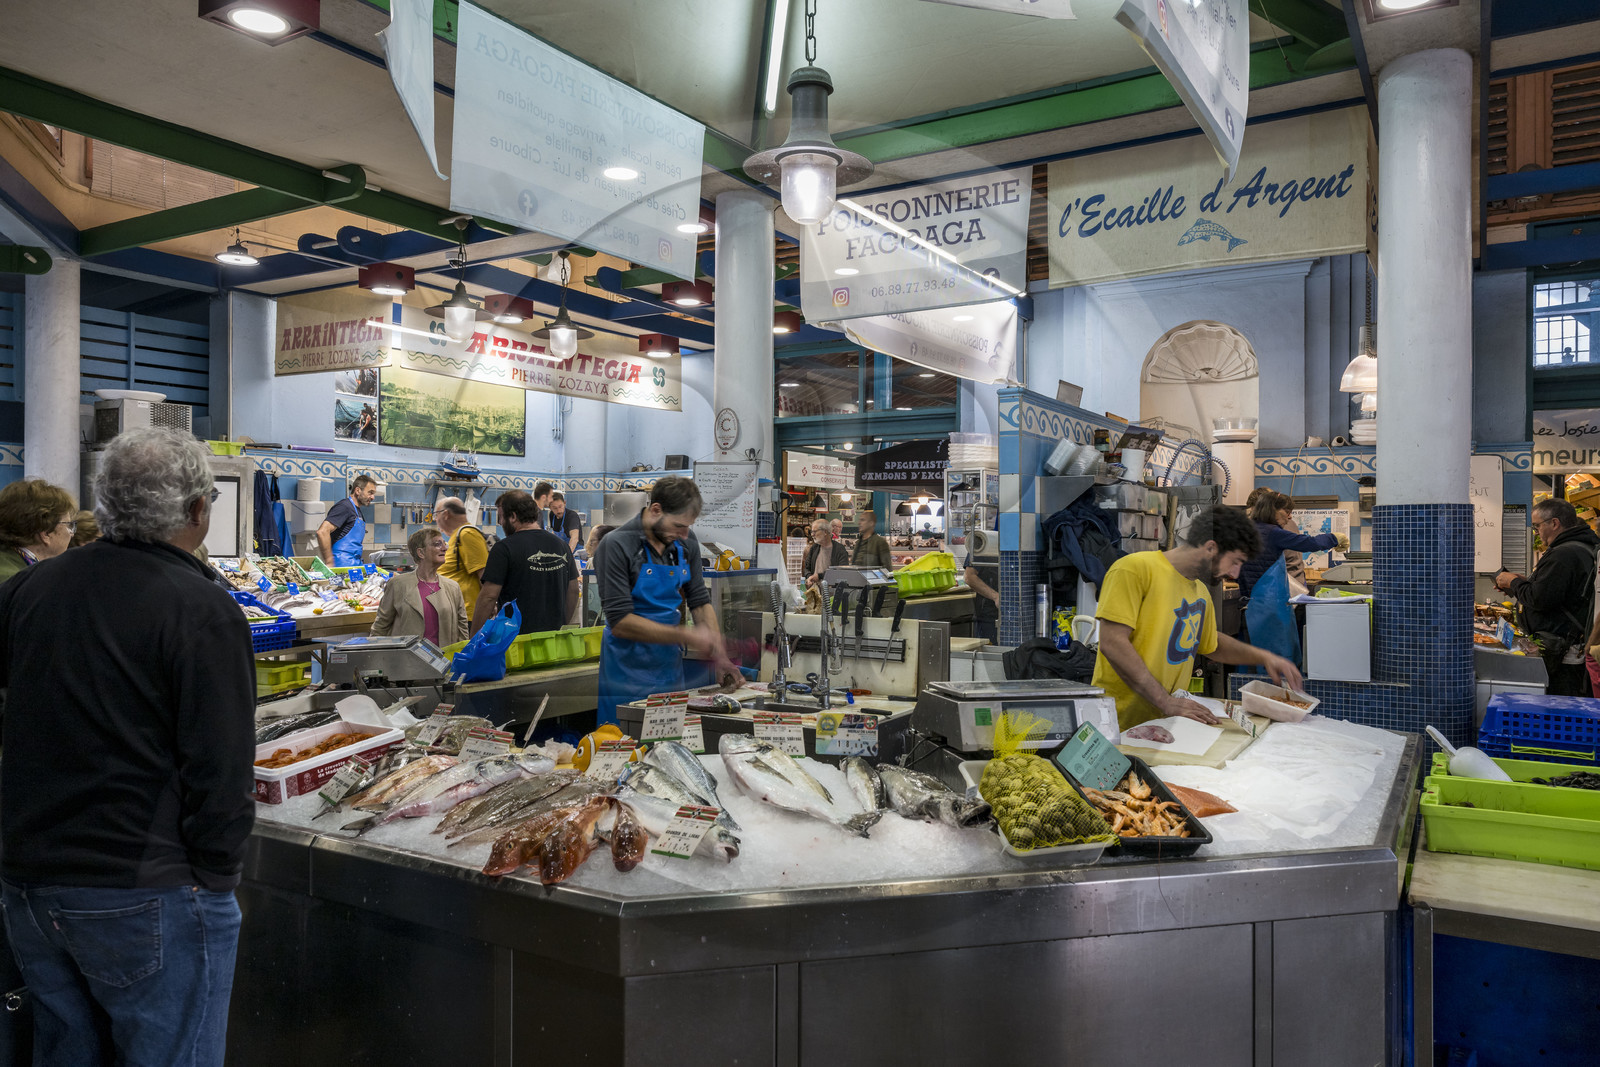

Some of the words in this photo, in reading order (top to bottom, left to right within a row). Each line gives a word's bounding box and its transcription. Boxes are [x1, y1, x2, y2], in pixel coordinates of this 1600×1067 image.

[817, 178, 1020, 236] POISSONNERIE
[871, 277, 956, 298] 06.89.77.93.48
[302, 353, 325, 368] PIERRE
[328, 347, 361, 366] ZOZAYA
[512, 366, 552, 386] PIERRE
[558, 375, 610, 397] ZOZAYA
[861, 471, 907, 480] JAMBONS
